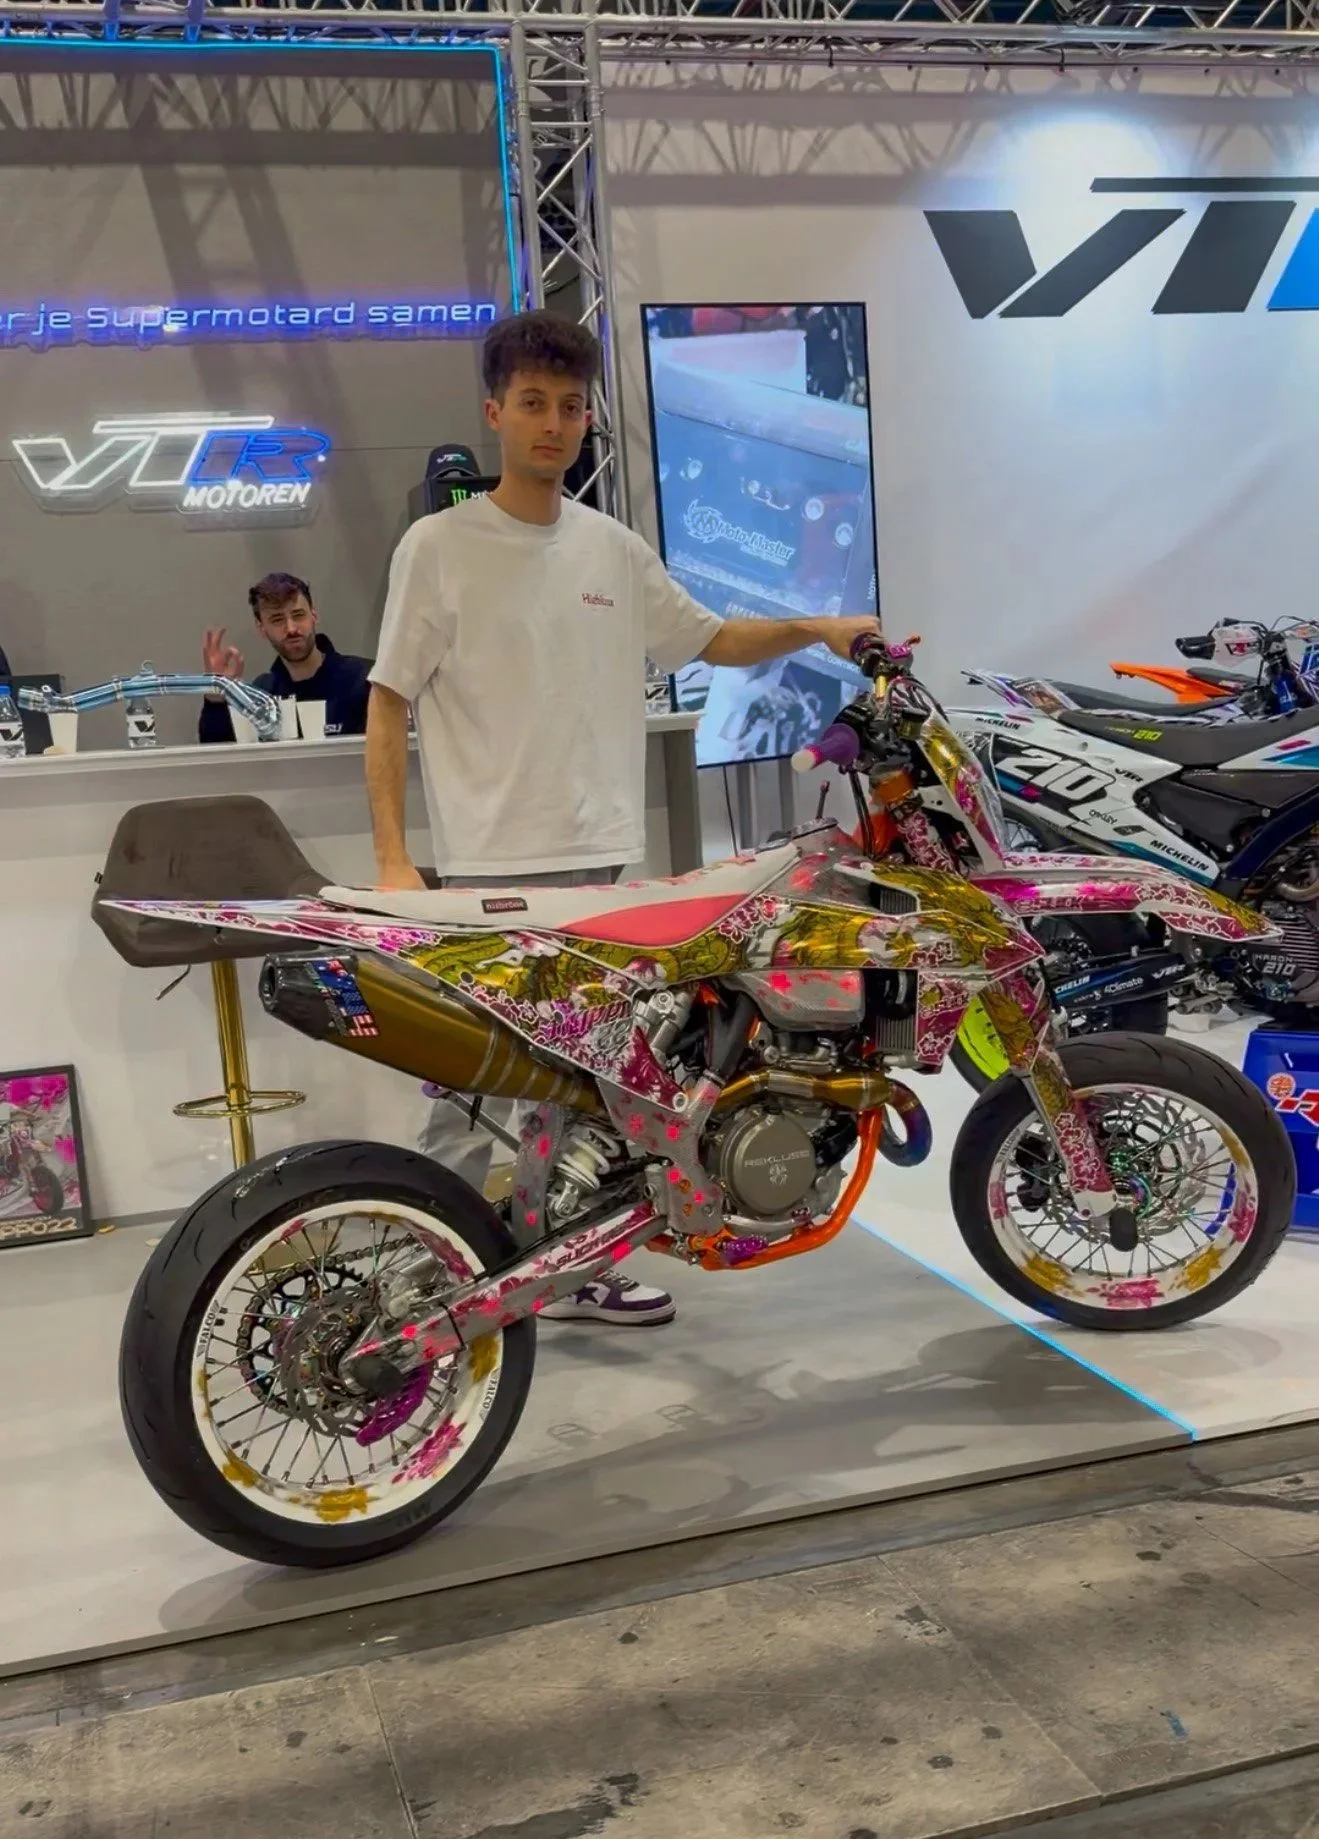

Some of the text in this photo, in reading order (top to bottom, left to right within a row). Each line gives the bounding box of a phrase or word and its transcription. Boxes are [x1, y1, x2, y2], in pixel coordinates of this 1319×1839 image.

[32, 303, 73, 336] je
[87, 302, 354, 335] Supermotard
[368, 303, 496, 324] samen
[11, 415, 331, 490] VTR
[182, 480, 311, 509] MOTOREN
[995, 748, 1112, 800] 210
[1150, 840, 1210, 871] MICHELIN
[1054, 975, 1091, 994] CHELIN
[1262, 961, 1296, 976] 210
[197, 1312, 216, 1345] FALCO
[482, 1378, 498, 1411] FALCO
